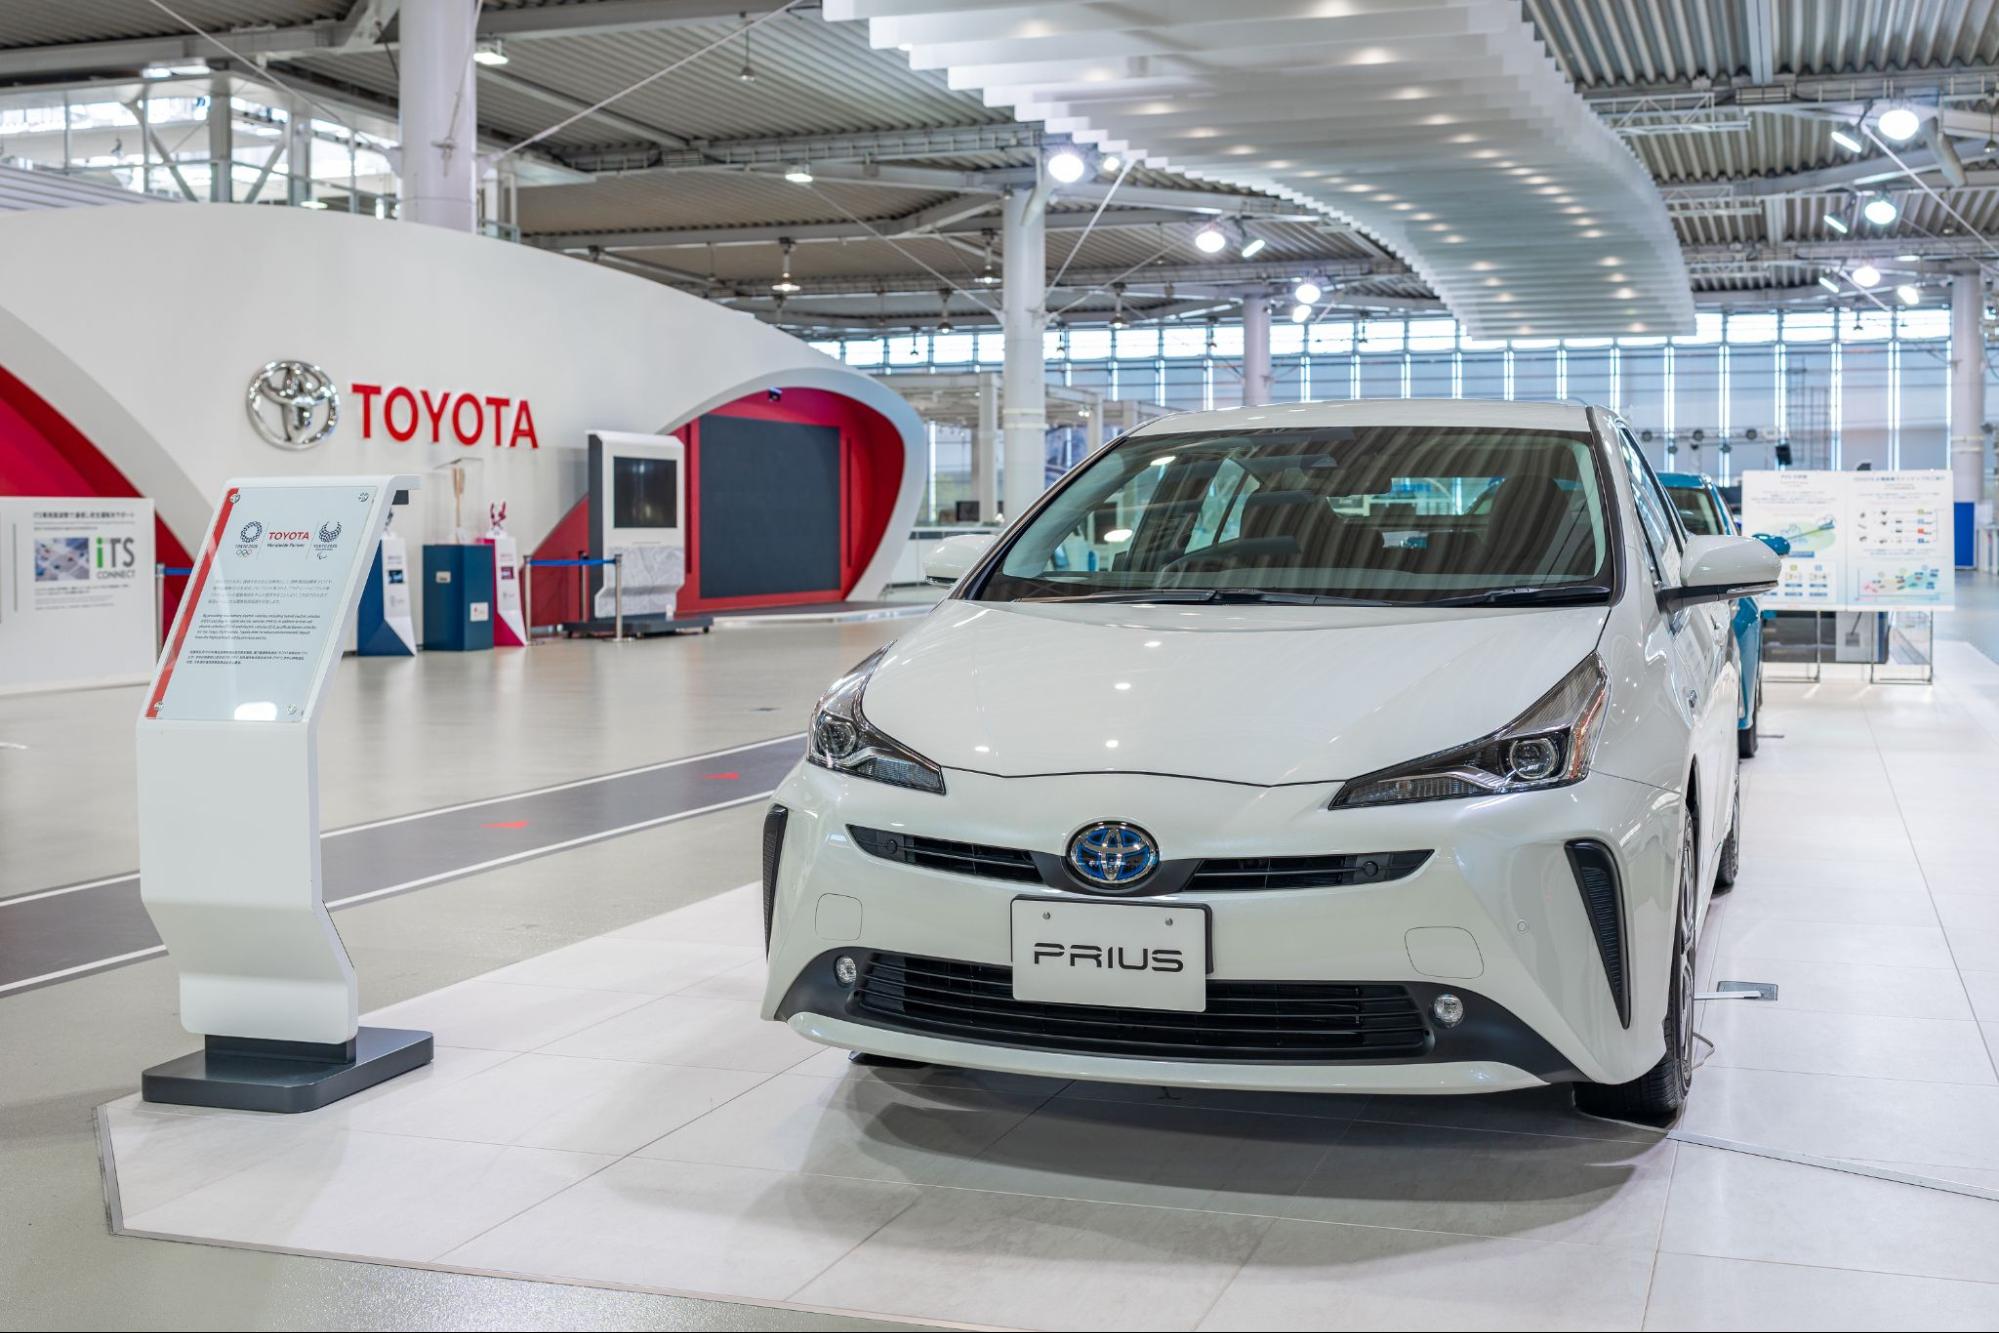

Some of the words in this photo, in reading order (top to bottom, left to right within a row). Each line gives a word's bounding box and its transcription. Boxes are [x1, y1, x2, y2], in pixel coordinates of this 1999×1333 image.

[351, 383, 539, 449] TOYOTA
[268, 531, 310, 541] TOYOTA
[96, 569, 136, 580] CONNECT
[1033, 942, 1184, 973] PRIUS
